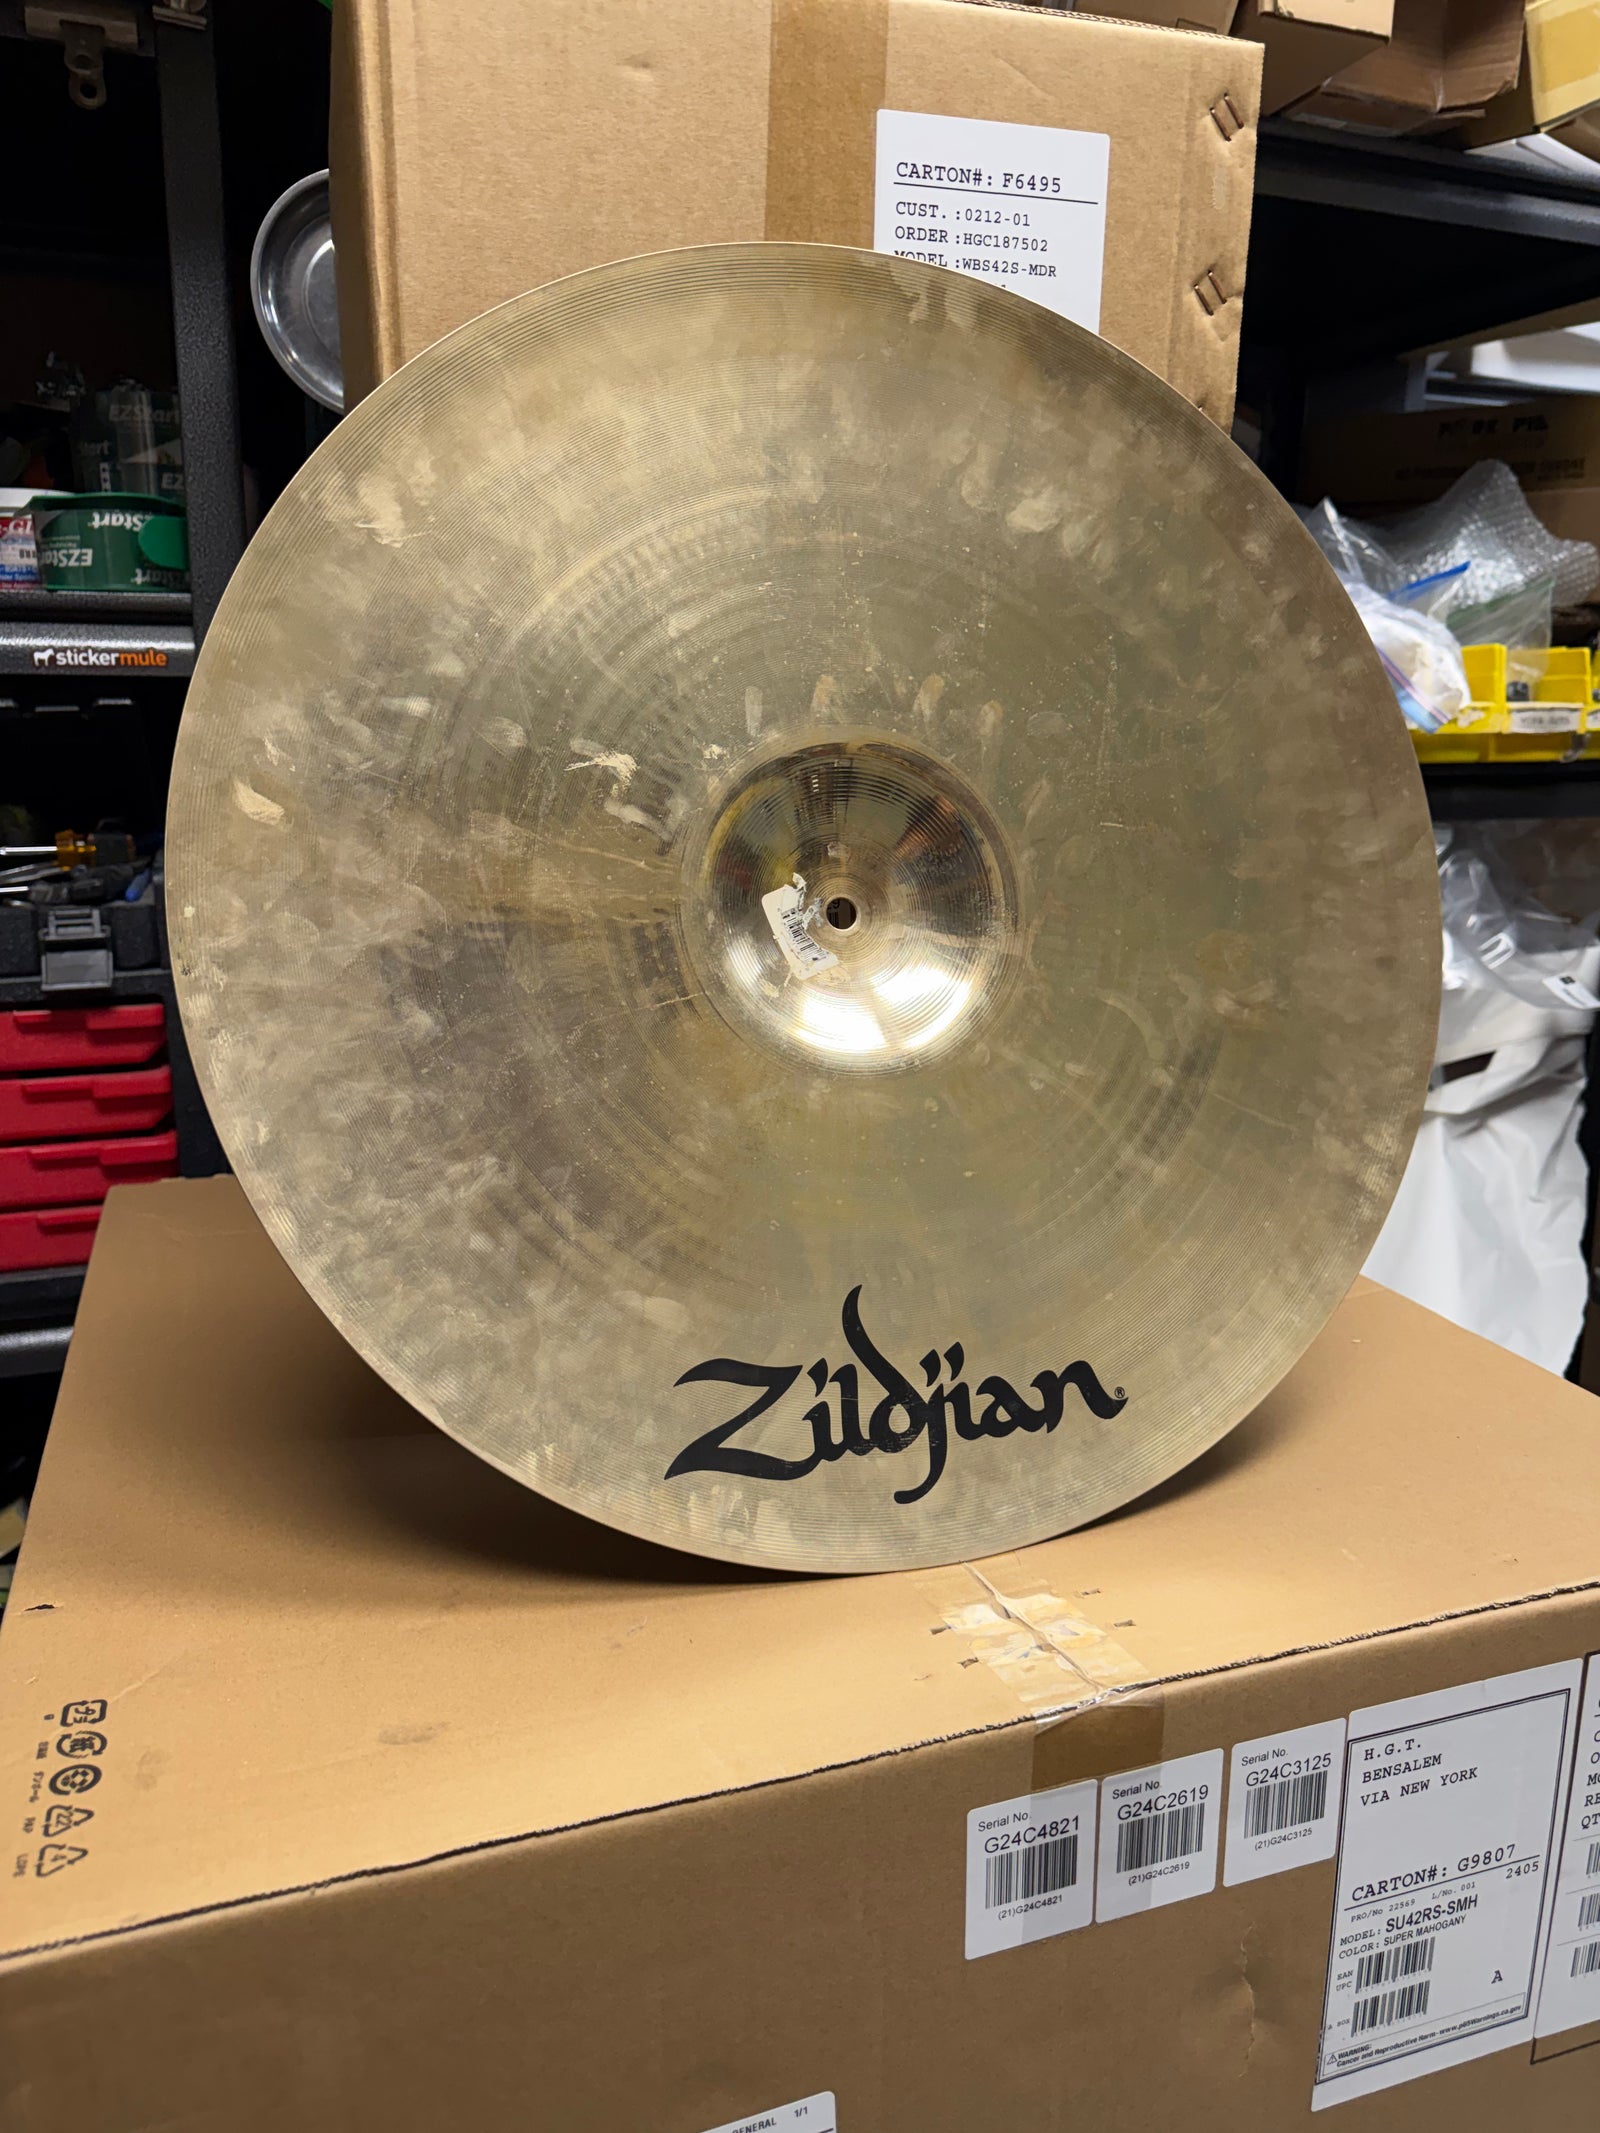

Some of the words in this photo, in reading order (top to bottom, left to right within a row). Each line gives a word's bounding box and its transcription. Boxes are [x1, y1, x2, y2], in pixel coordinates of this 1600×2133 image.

[896, 162, 993, 187] CARTON#:
[1002, 173, 1061, 193] F6495
[895, 226, 949, 243] ORDER
[56, 649, 167, 667] stickermule
[664, 1284, 1129, 1504] Zildjian
[1241, 1750, 1269, 1767] Serial
[1272, 1748, 1289, 1759] No.
[1364, 1738, 1422, 1761] H.G.T.
[1246, 1753, 1331, 1787] G24C3125
[1362, 1753, 1442, 1783] BENSALEM
[1112, 1784, 1141, 1800] Serial
[1361, 1790, 1390, 1807] VIA
[1400, 1780, 1430, 1798] NEW
[1440, 1767, 1478, 1787] YORK
[1117, 1784, 1209, 1820] G24C2619
[978, 1815, 1009, 1832] Serial
[984, 1815, 1079, 1853] G24C4821
[1255, 1827, 1312, 1851] (21)G24C3125
[1128, 1861, 1190, 1886] (21)G24C2619
[1352, 1865, 1447, 1901] CARTON#:
[1457, 1844, 1516, 1873] G9807
[1505, 1861, 1540, 1879] 2405
[998, 1895, 1063, 1920] (21)G24C4821
[1351, 1908, 1383, 1922] PRO/No
[1385, 1894, 1478, 1933] SU42RS-SMH
[1384, 1929, 1414, 1946] SUPER
[1415, 1914, 1467, 1937] MAHOGANY
[1491, 1969, 1503, 1984] A
[794, 2106, 808, 2117] 1/1
